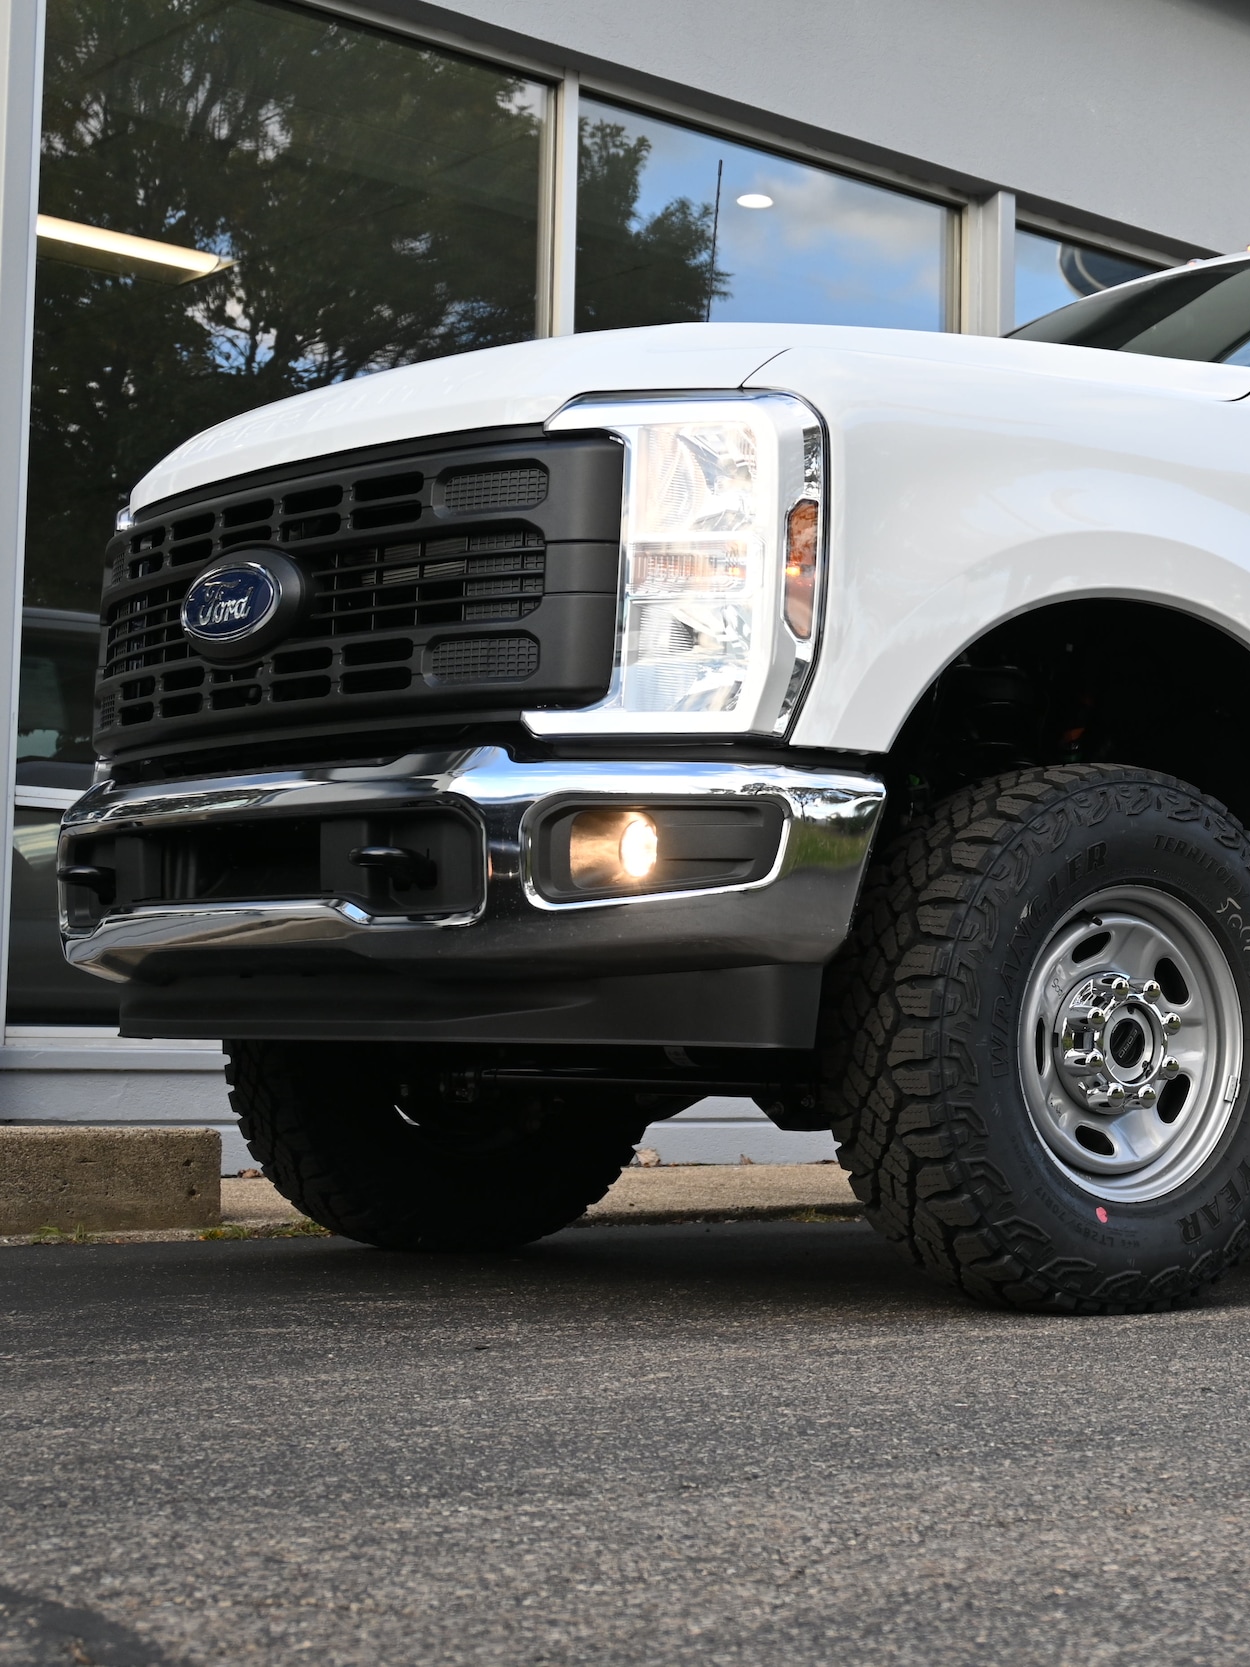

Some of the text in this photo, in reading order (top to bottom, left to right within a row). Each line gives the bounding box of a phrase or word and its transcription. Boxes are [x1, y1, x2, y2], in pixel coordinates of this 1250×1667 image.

[199, 579, 254, 625] Ford
[990, 840, 1108, 1078] WRANGLER
[1117, 1028, 1138, 1059] FORD
